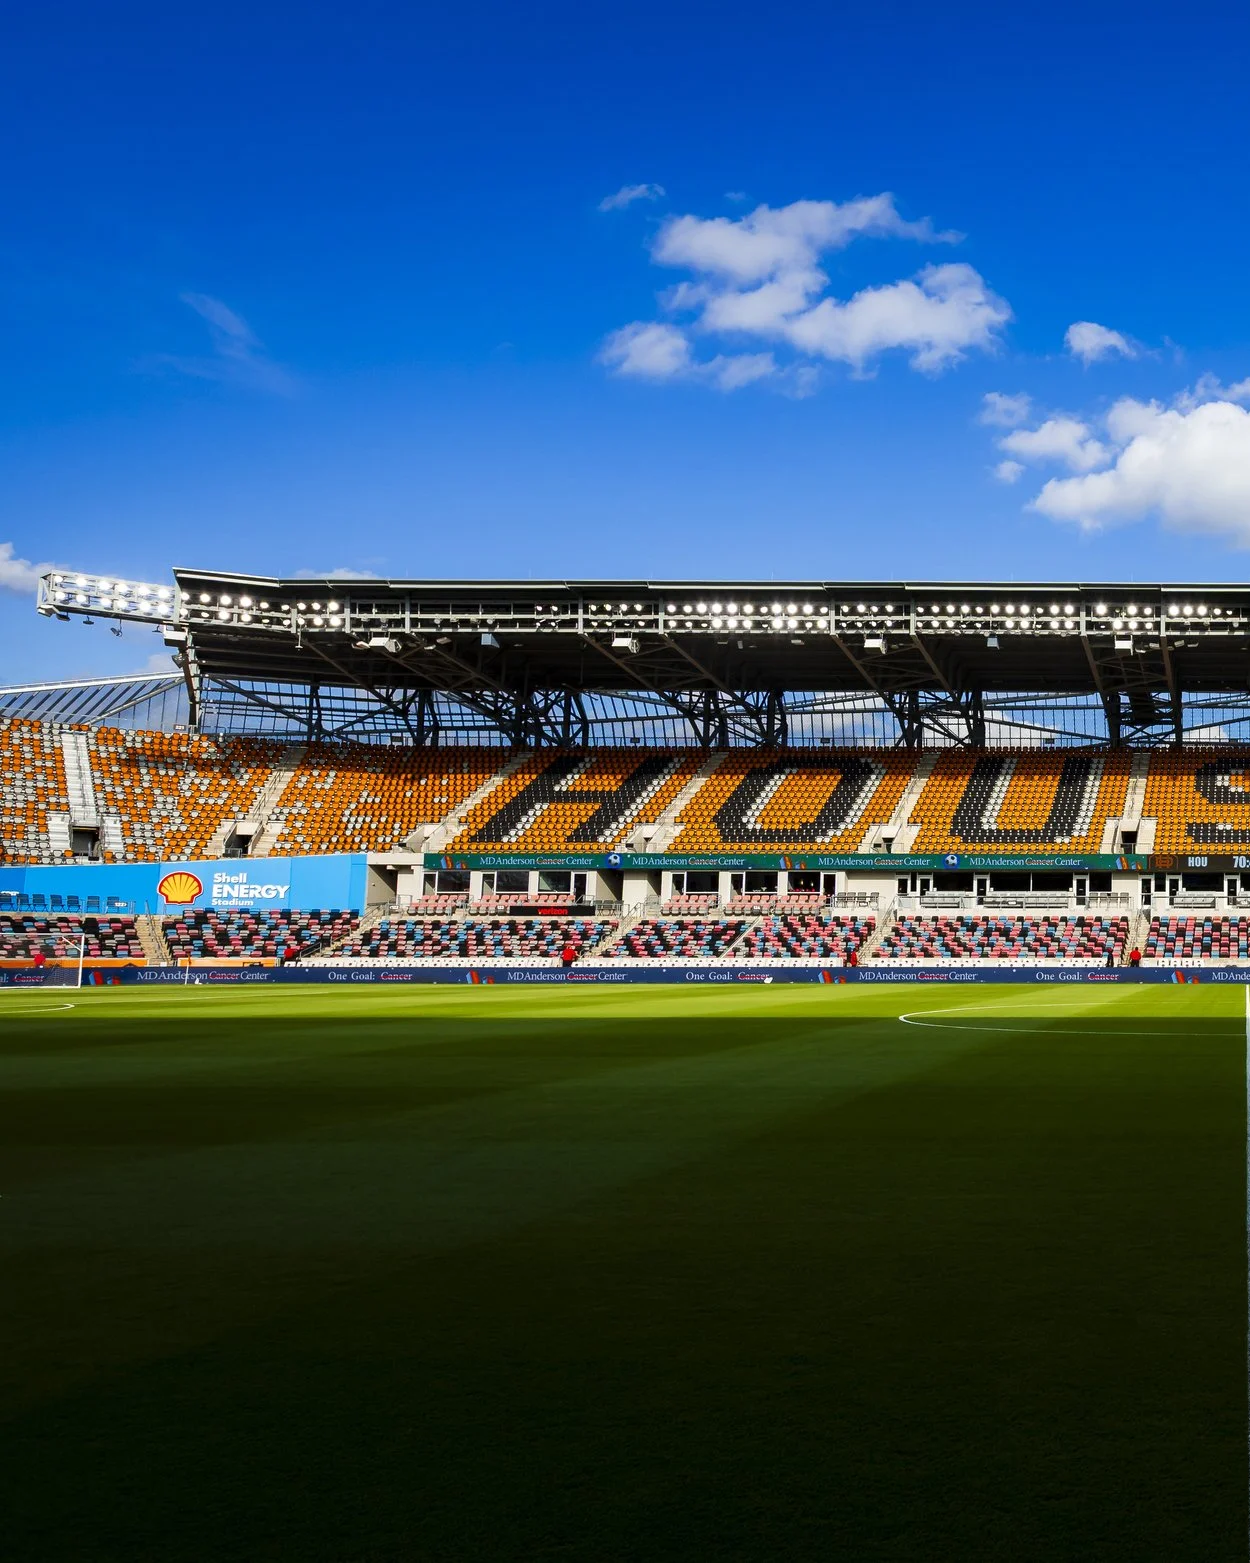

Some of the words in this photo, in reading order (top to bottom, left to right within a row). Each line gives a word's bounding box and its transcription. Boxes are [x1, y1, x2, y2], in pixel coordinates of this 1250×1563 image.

[536, 856, 565, 865] Cancer
[566, 856, 592, 865] Center
[688, 856, 717, 865] Cancer
[718, 856, 744, 865] Center
[874, 857, 903, 865] Cancer
[904, 857, 930, 865] Center
[1025, 857, 1054, 866] Cancer
[1054, 857, 1081, 866] Center
[1188, 856, 1208, 867] HOU
[213, 872, 247, 884] Shell
[212, 884, 290, 899] ENERGY
[538, 907, 568, 915] verizon
[208, 971, 240, 980] Cancer
[240, 971, 268, 980] Center
[329, 971, 347, 981] One
[351, 971, 376, 981] Goal:
[380, 971, 412, 981] Cancer
[567, 971, 598, 981] Cancer
[598, 971, 625, 981] Center
[686, 971, 704, 981] One
[709, 971, 733, 981] Goal:
[738, 971, 770, 981] Cancer
[917, 971, 949, 981] Cancer
[949, 971, 976, 981] Center
[1036, 971, 1054, 981] One
[1059, 971, 1082, 981] Goal:
[1088, 971, 1119, 981] Cancer
